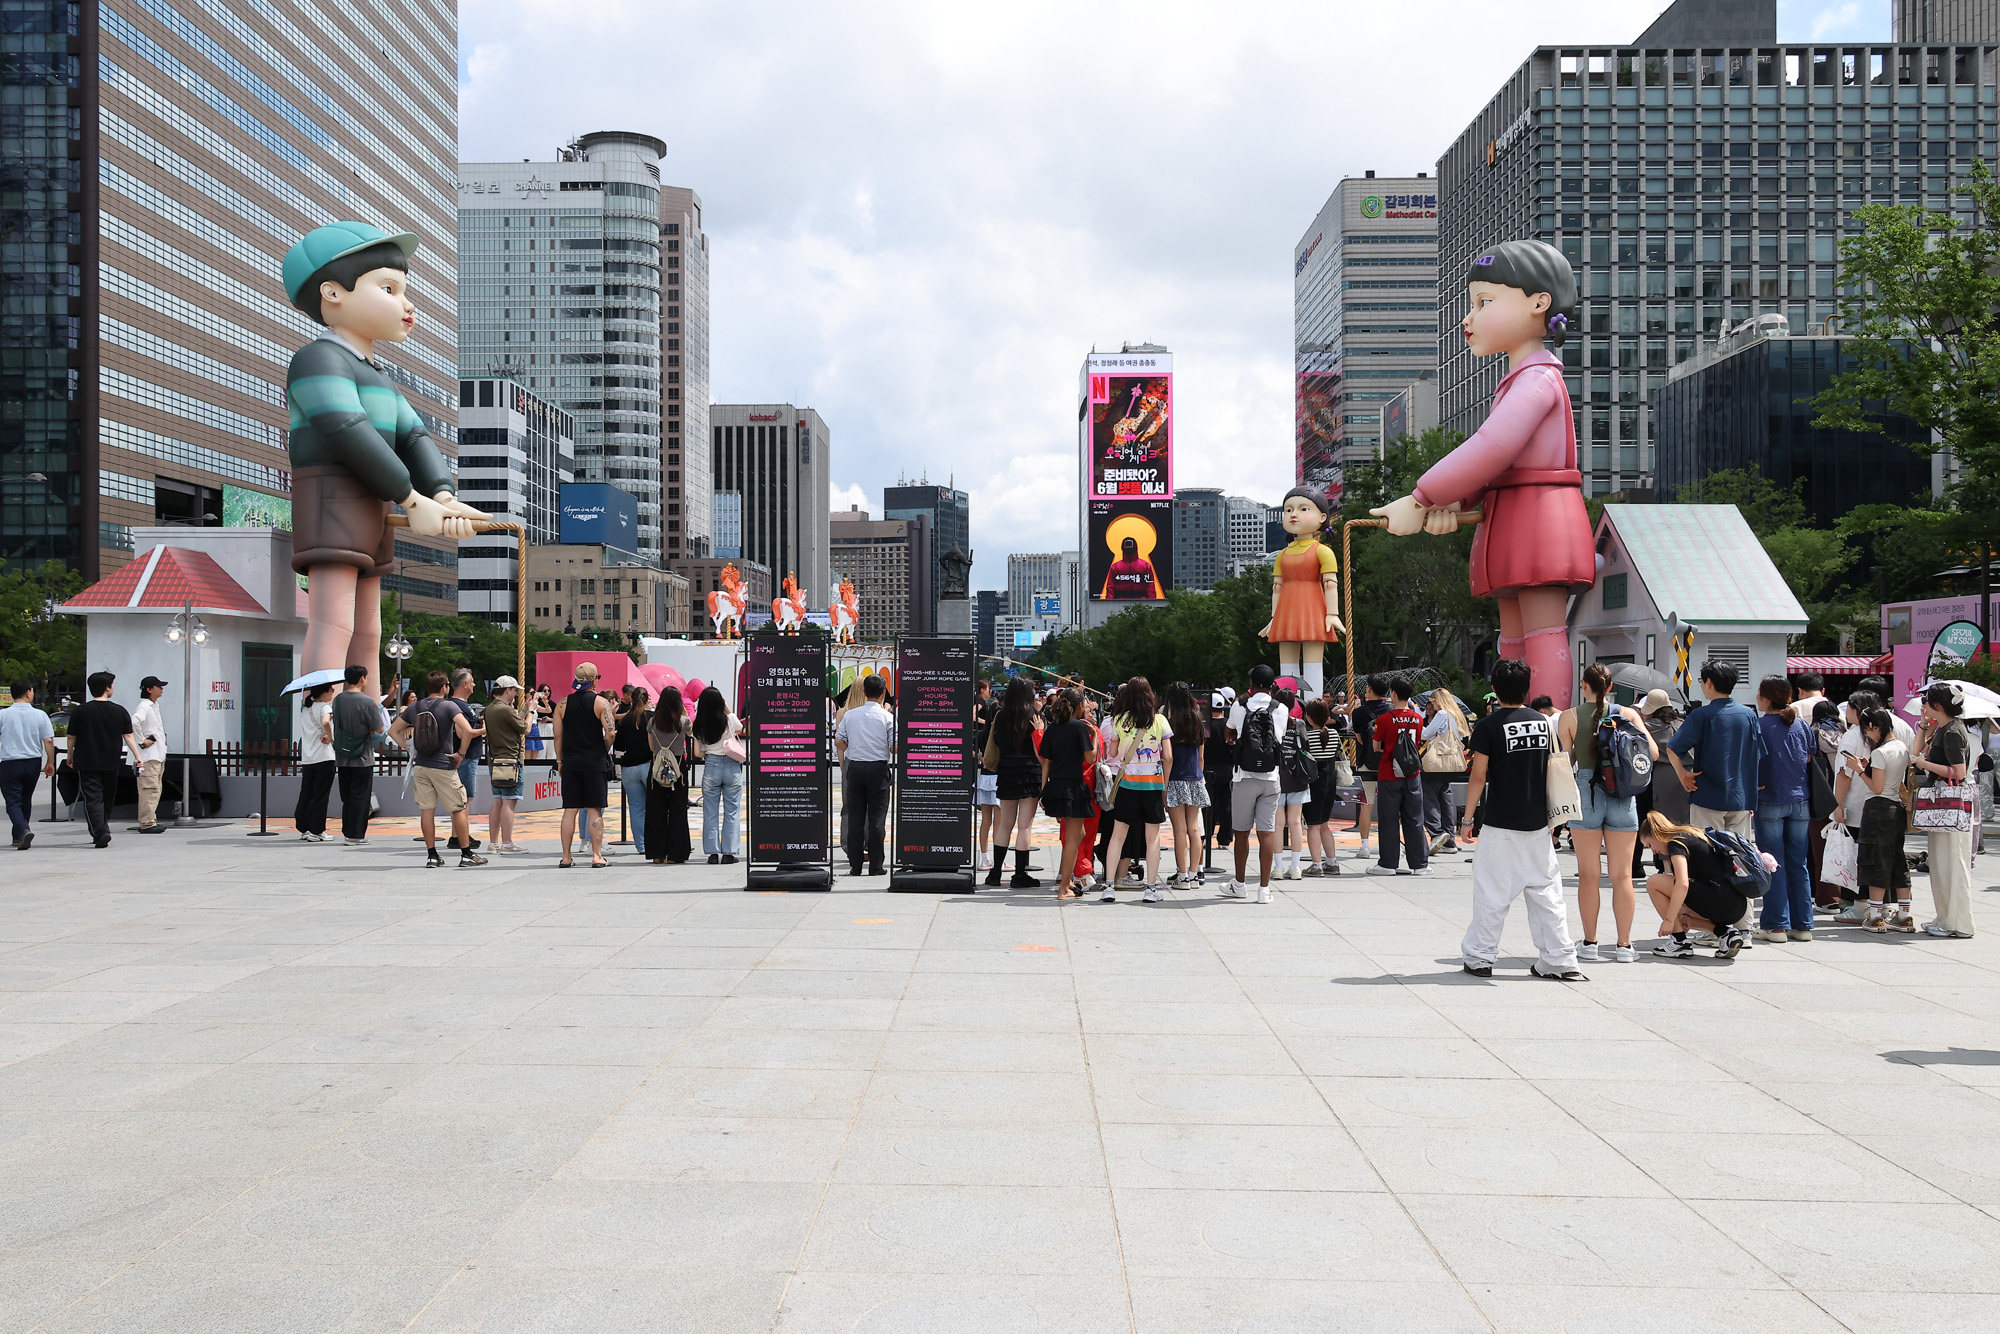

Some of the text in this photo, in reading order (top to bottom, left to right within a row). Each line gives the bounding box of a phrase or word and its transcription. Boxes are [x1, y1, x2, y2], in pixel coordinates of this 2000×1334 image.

[1385, 210, 1424, 218] Methodist
[1093, 377, 1105, 399] N
[750, 413, 778, 421] kobaco
[1104, 469, 1158, 481] 준비됐어?
[1098, 482, 1164, 494] 6월 넷플에서
[1948, 636, 1958, 644] MY
[768, 668, 808, 676] 영희&철수
[758, 678, 818, 686] 단체 줄넘기 게임
[212, 682, 230, 692] NETFLIX
[535, 782, 562, 800] NETFL
